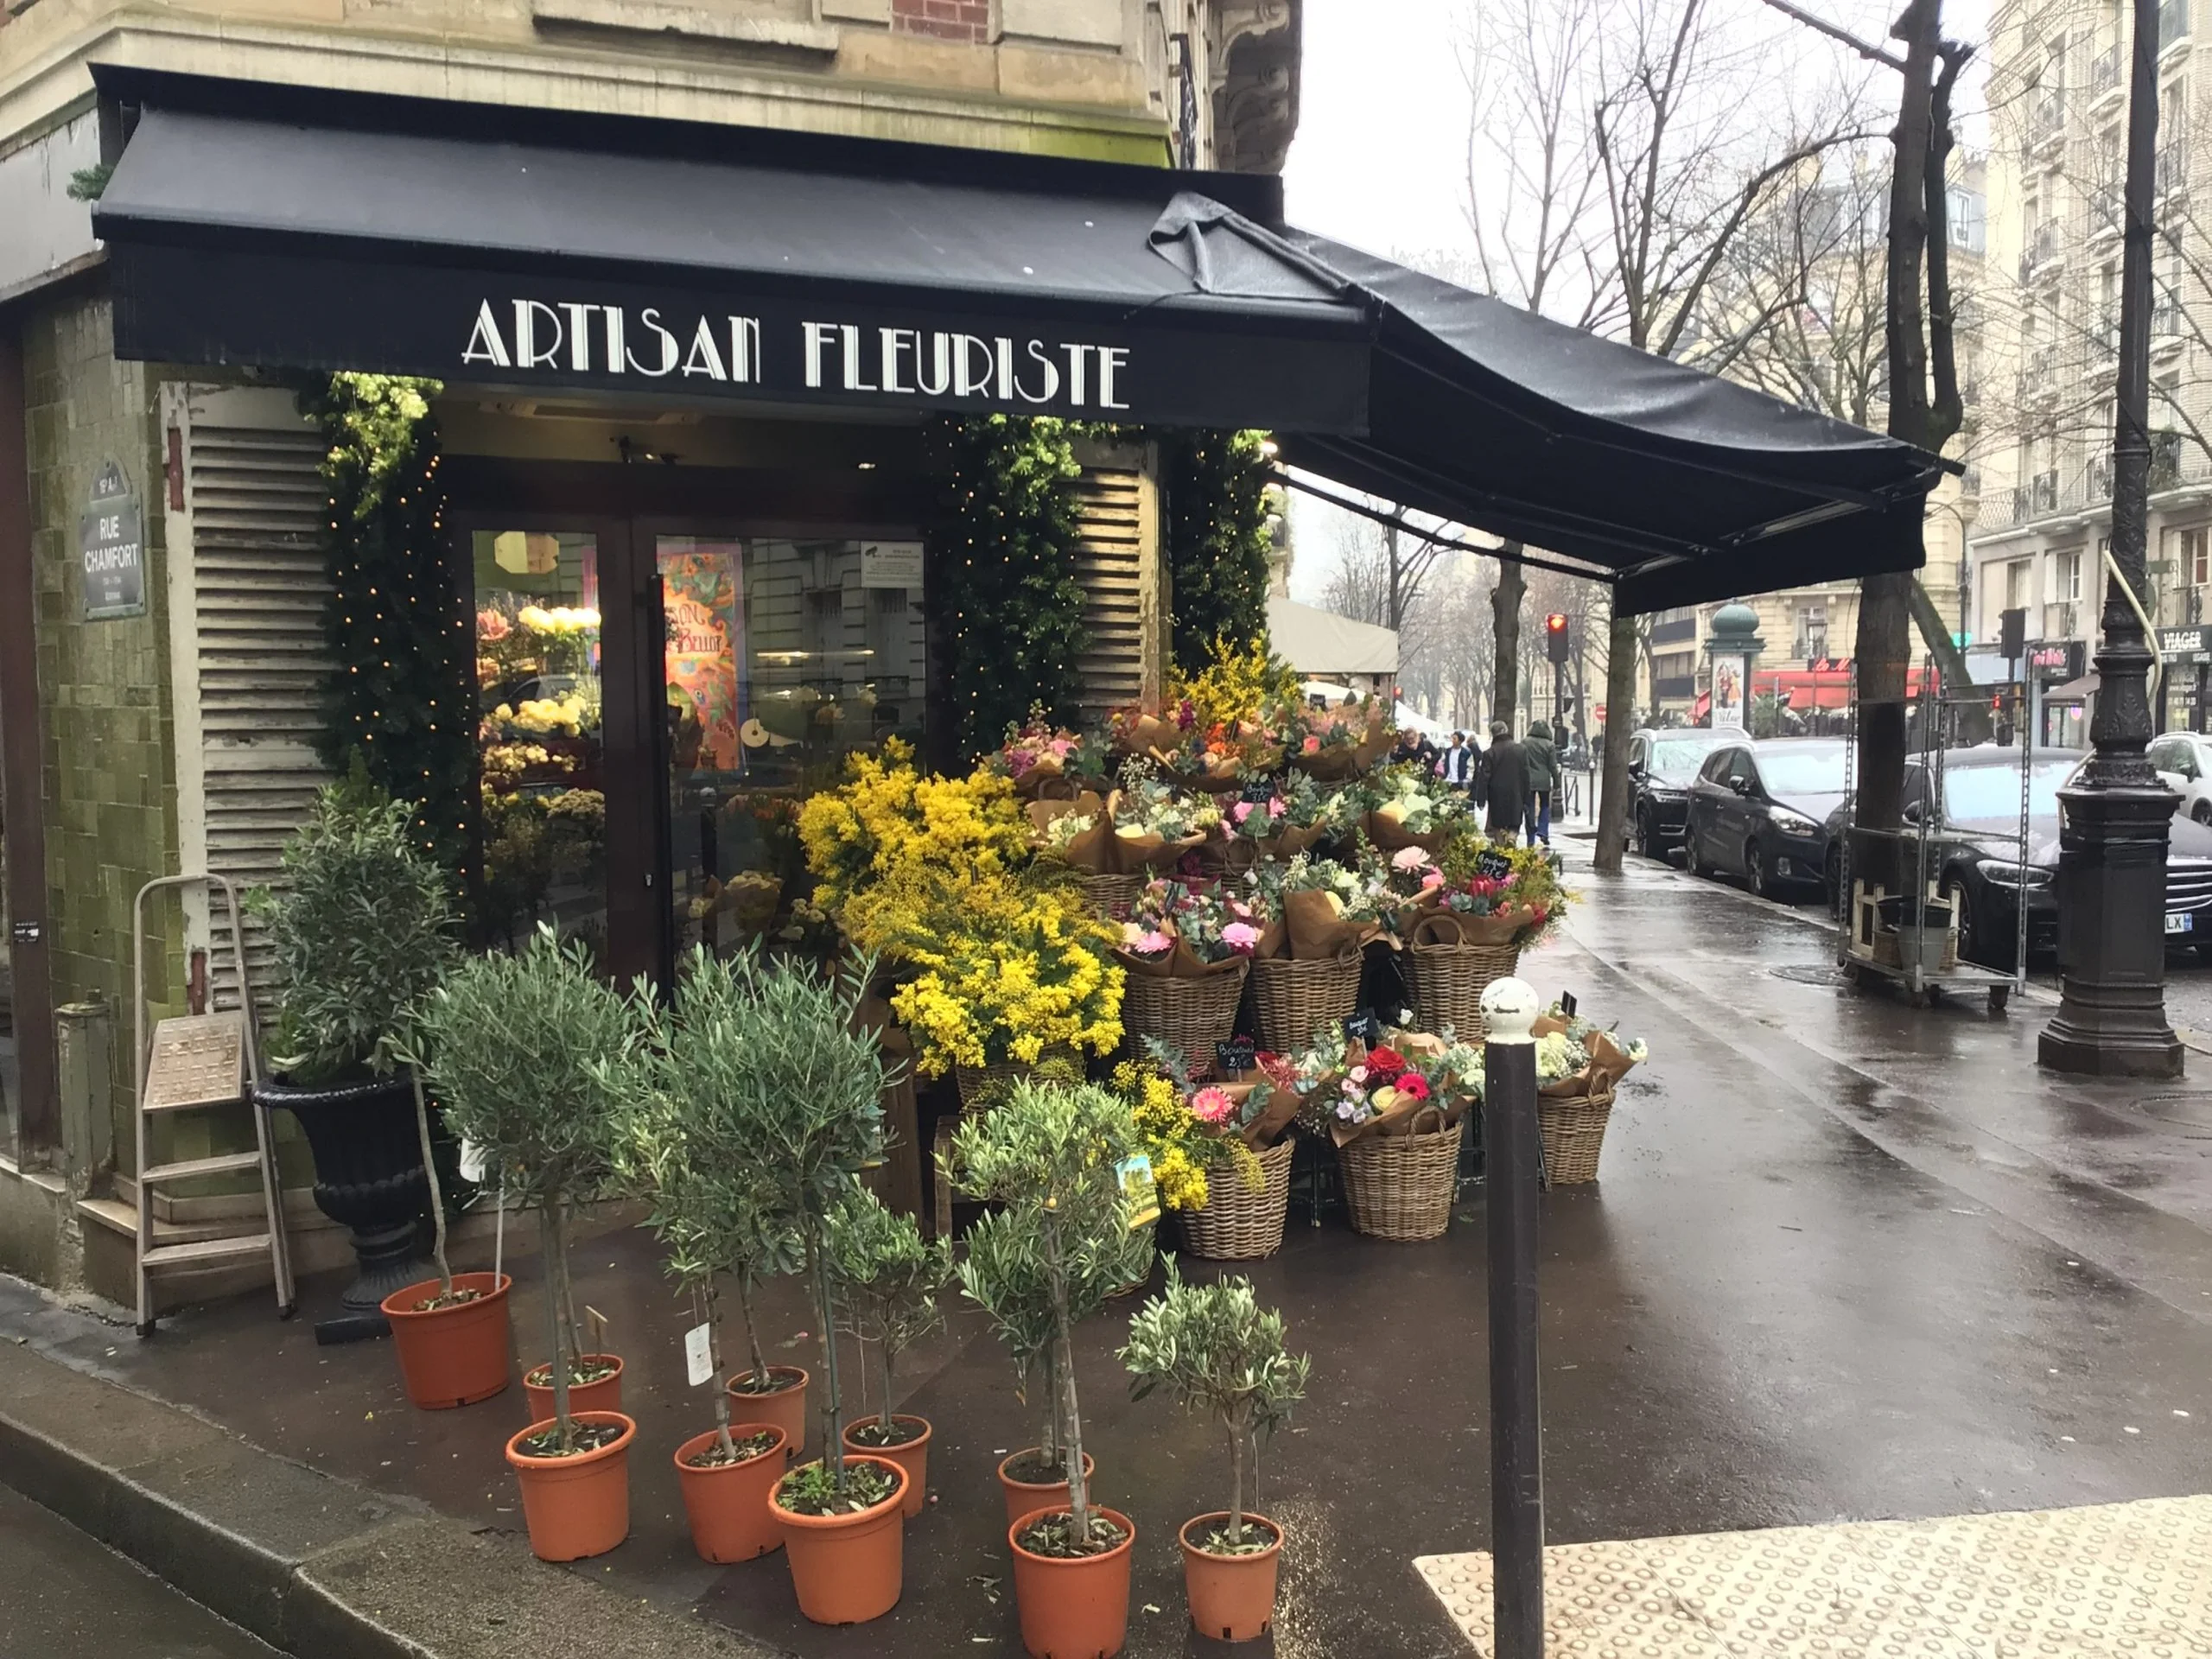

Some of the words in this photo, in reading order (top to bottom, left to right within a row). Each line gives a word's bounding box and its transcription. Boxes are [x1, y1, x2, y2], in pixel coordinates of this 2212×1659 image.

[461, 298, 760, 383] ARTISAN
[802, 321, 1130, 409] FLEURISTE
[99, 516, 120, 541] RUE
[85, 543, 138, 574] CHAMFORT
[2164, 632, 2202, 650] VIAGER
